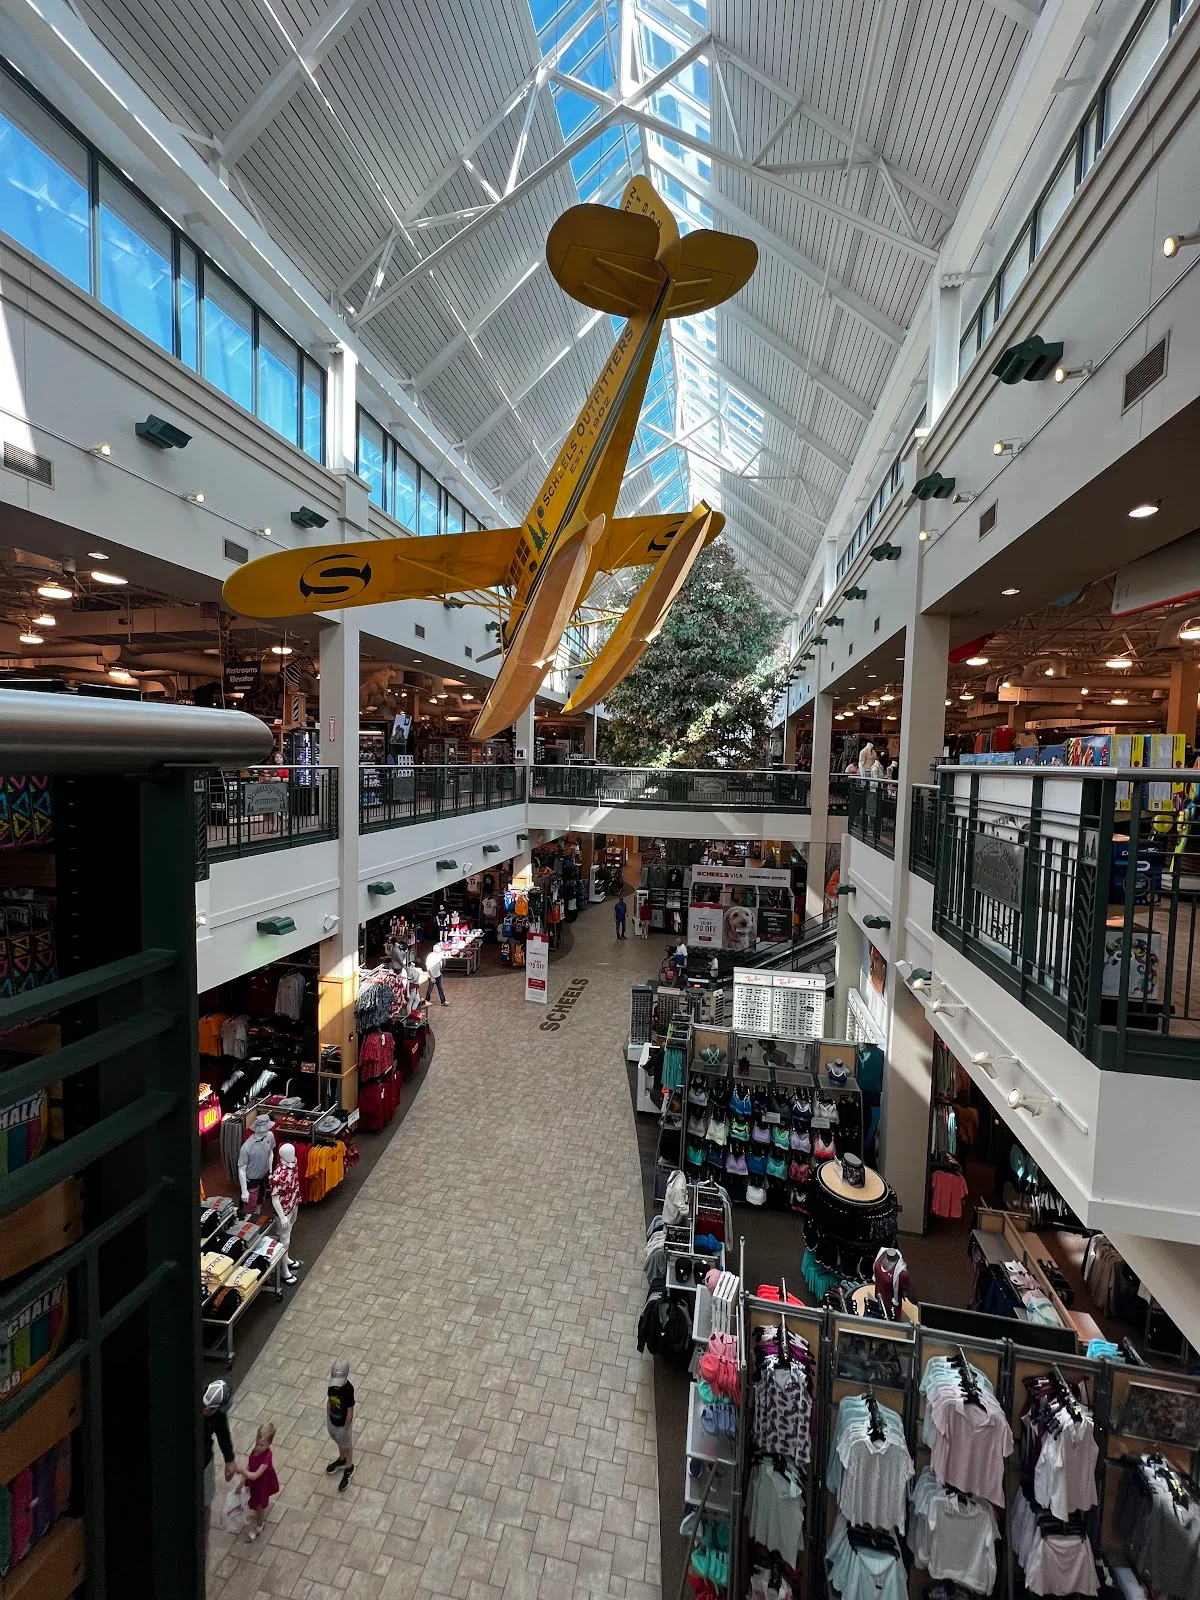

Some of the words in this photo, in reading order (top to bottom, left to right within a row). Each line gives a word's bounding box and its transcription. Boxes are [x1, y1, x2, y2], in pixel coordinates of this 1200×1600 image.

[542, 440, 578, 507] SCHEELS
[576, 325, 634, 438] OUTFITTERS
[588, 396, 611, 437] 1902
[538, 978, 590, 1032] SCHEELS
[0, 1098, 44, 1131] HALK
[8, 1284, 64, 1339] CHALK
